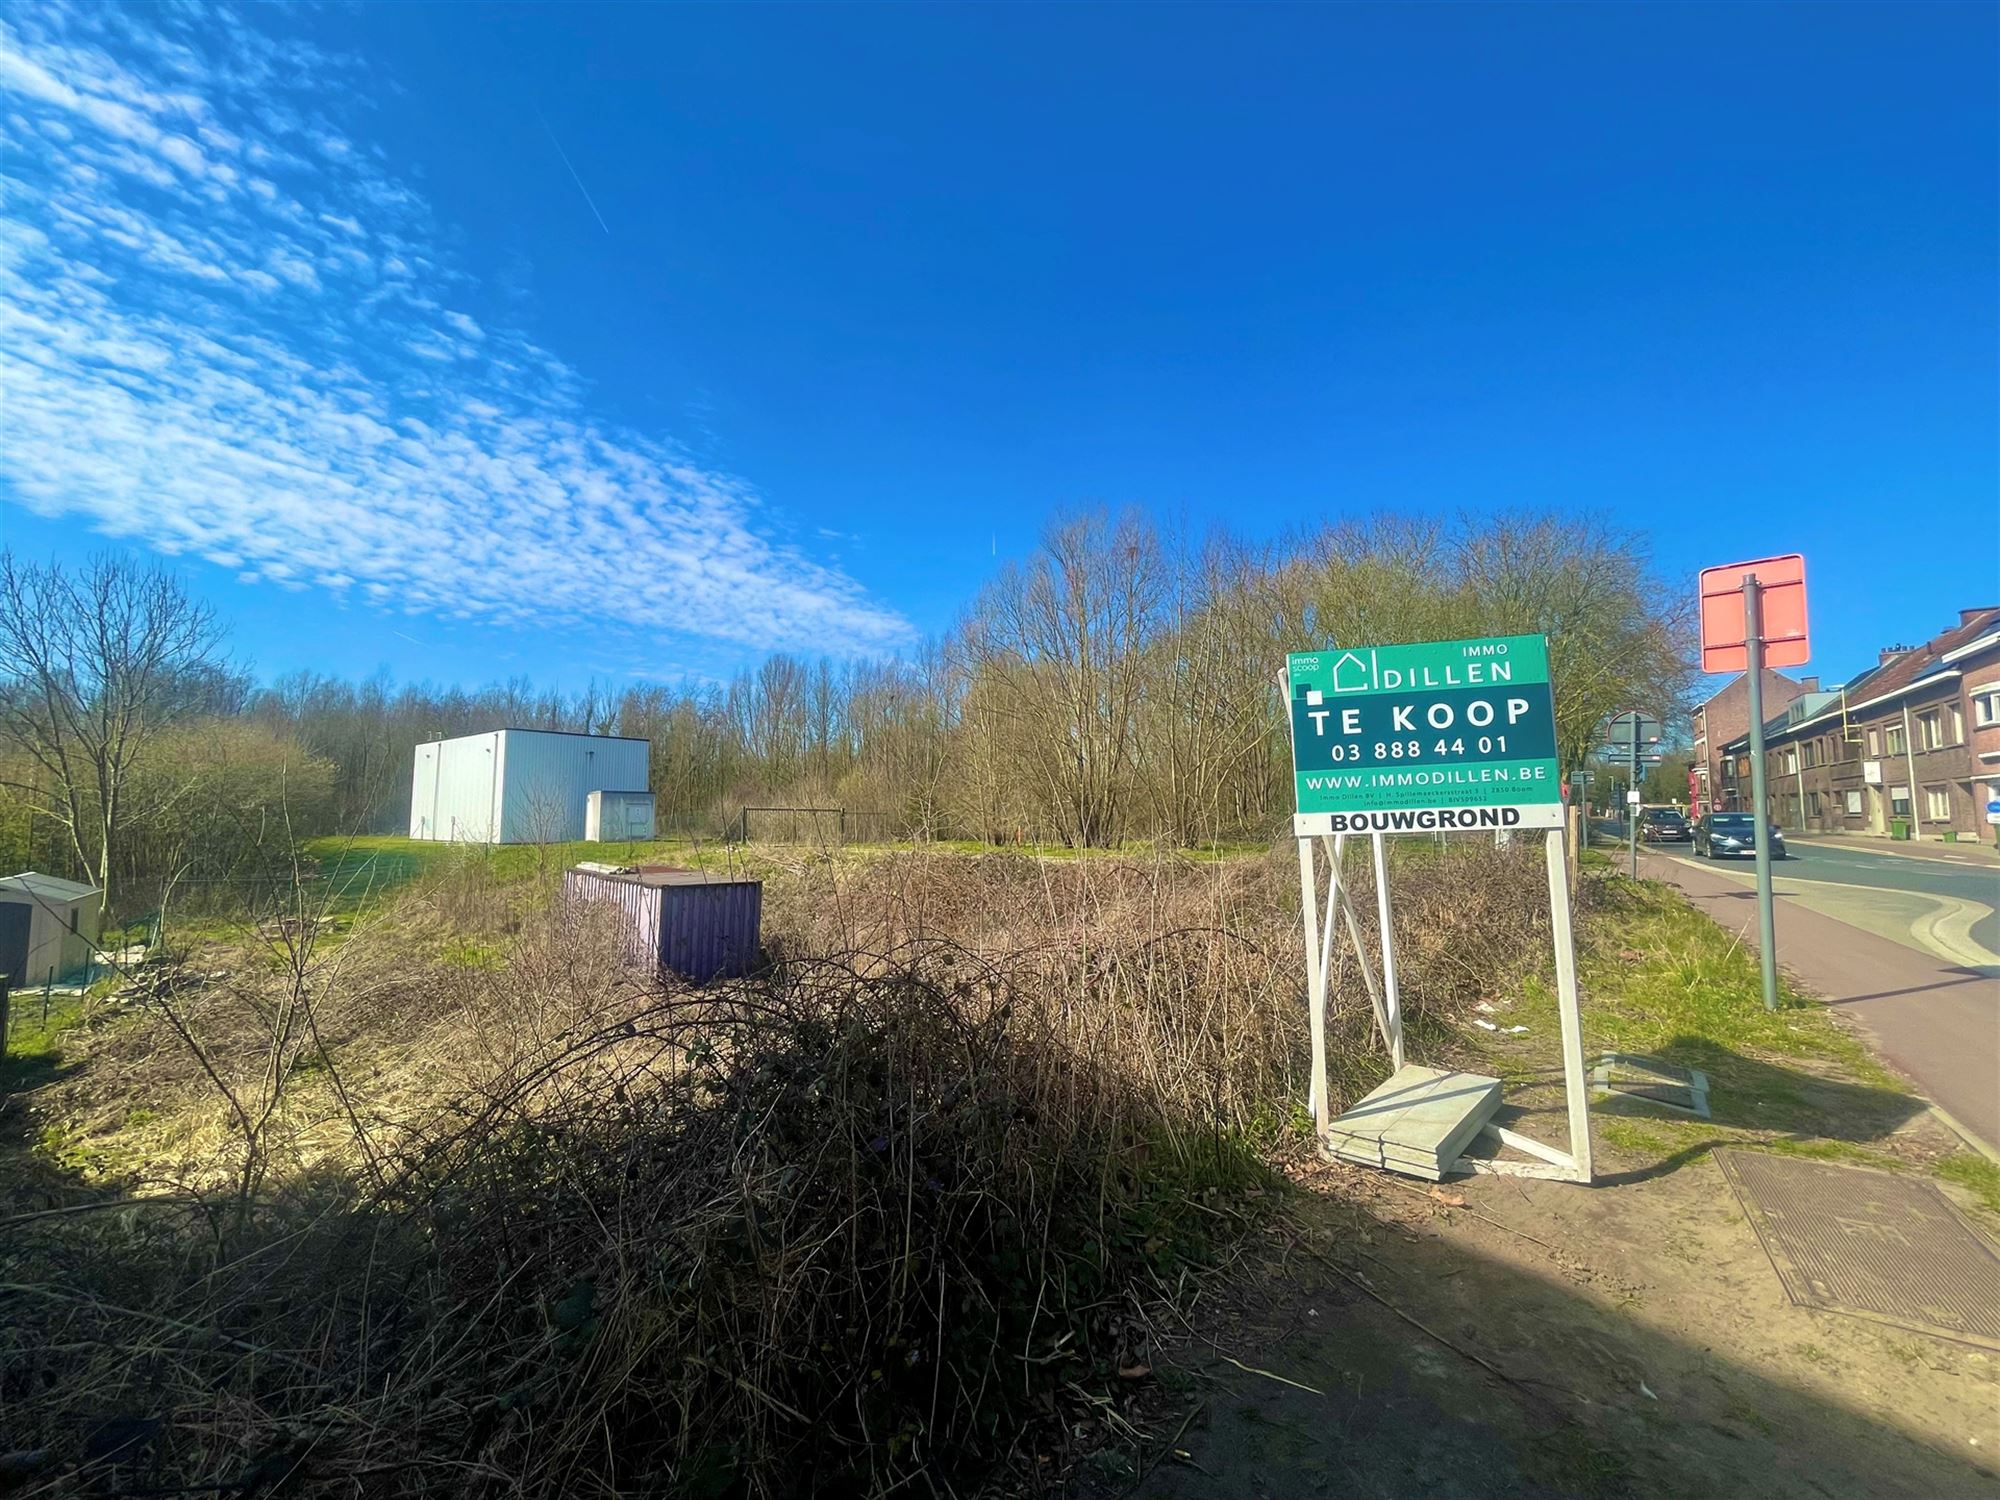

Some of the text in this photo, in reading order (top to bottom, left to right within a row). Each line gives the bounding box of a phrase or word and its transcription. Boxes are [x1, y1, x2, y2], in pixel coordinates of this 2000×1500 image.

[1291, 656, 1319, 665] immo
[1463, 643, 1509, 658] IMMO
[1292, 664, 1319, 673] scoop
[1383, 661, 1512, 690] DILLEN
[1308, 698, 1530, 736] TE KOOP
[1331, 735, 1506, 762] 03 888 44 01
[1306, 766, 1546, 790] WWW.IMMODILLEN.BE
[1331, 808, 1520, 832] BOUWGROND
